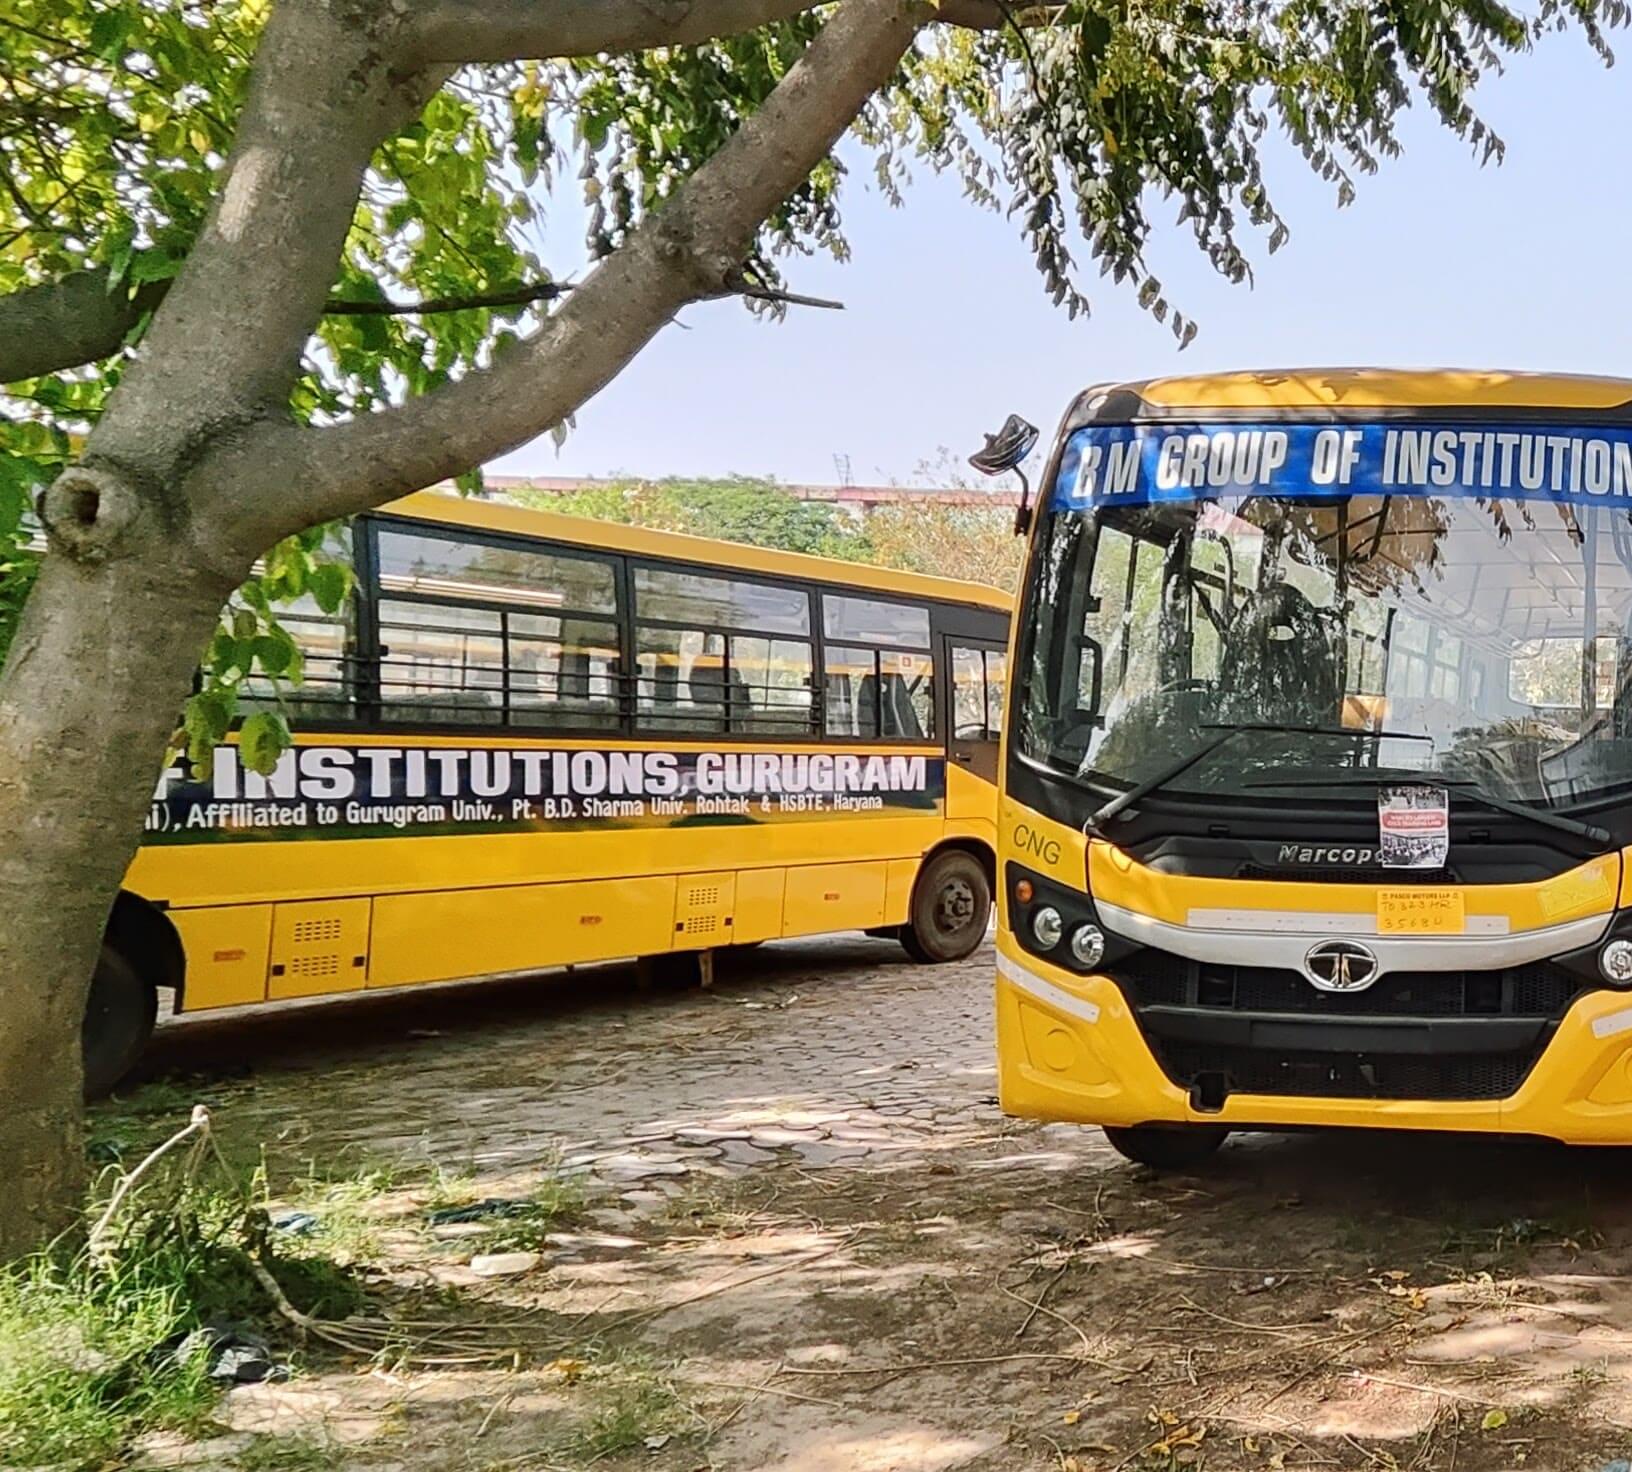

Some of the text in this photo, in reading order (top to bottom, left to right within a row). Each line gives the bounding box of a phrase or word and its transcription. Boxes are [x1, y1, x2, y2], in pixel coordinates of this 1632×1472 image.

[1156, 431, 1288, 490] GROUP
[1311, 430, 1363, 486] OF
[697, 753, 927, 794] GURUGRAM
[187, 803, 307, 831] Affiliated
[316, 803, 338, 825] to
[346, 800, 445, 829] Gurugram
[452, 798, 504, 823] Univ.,
[512, 797, 537, 819] Pt.
[544, 796, 577, 819] B.D.
[582, 796, 643, 818] Sharma
[651, 795, 689, 816] Univ.
[696, 794, 750, 815] Rohtak
[760, 796, 771, 814] &
[833, 792, 883, 812] Haryana
[1014, 824, 1061, 865] CNG
